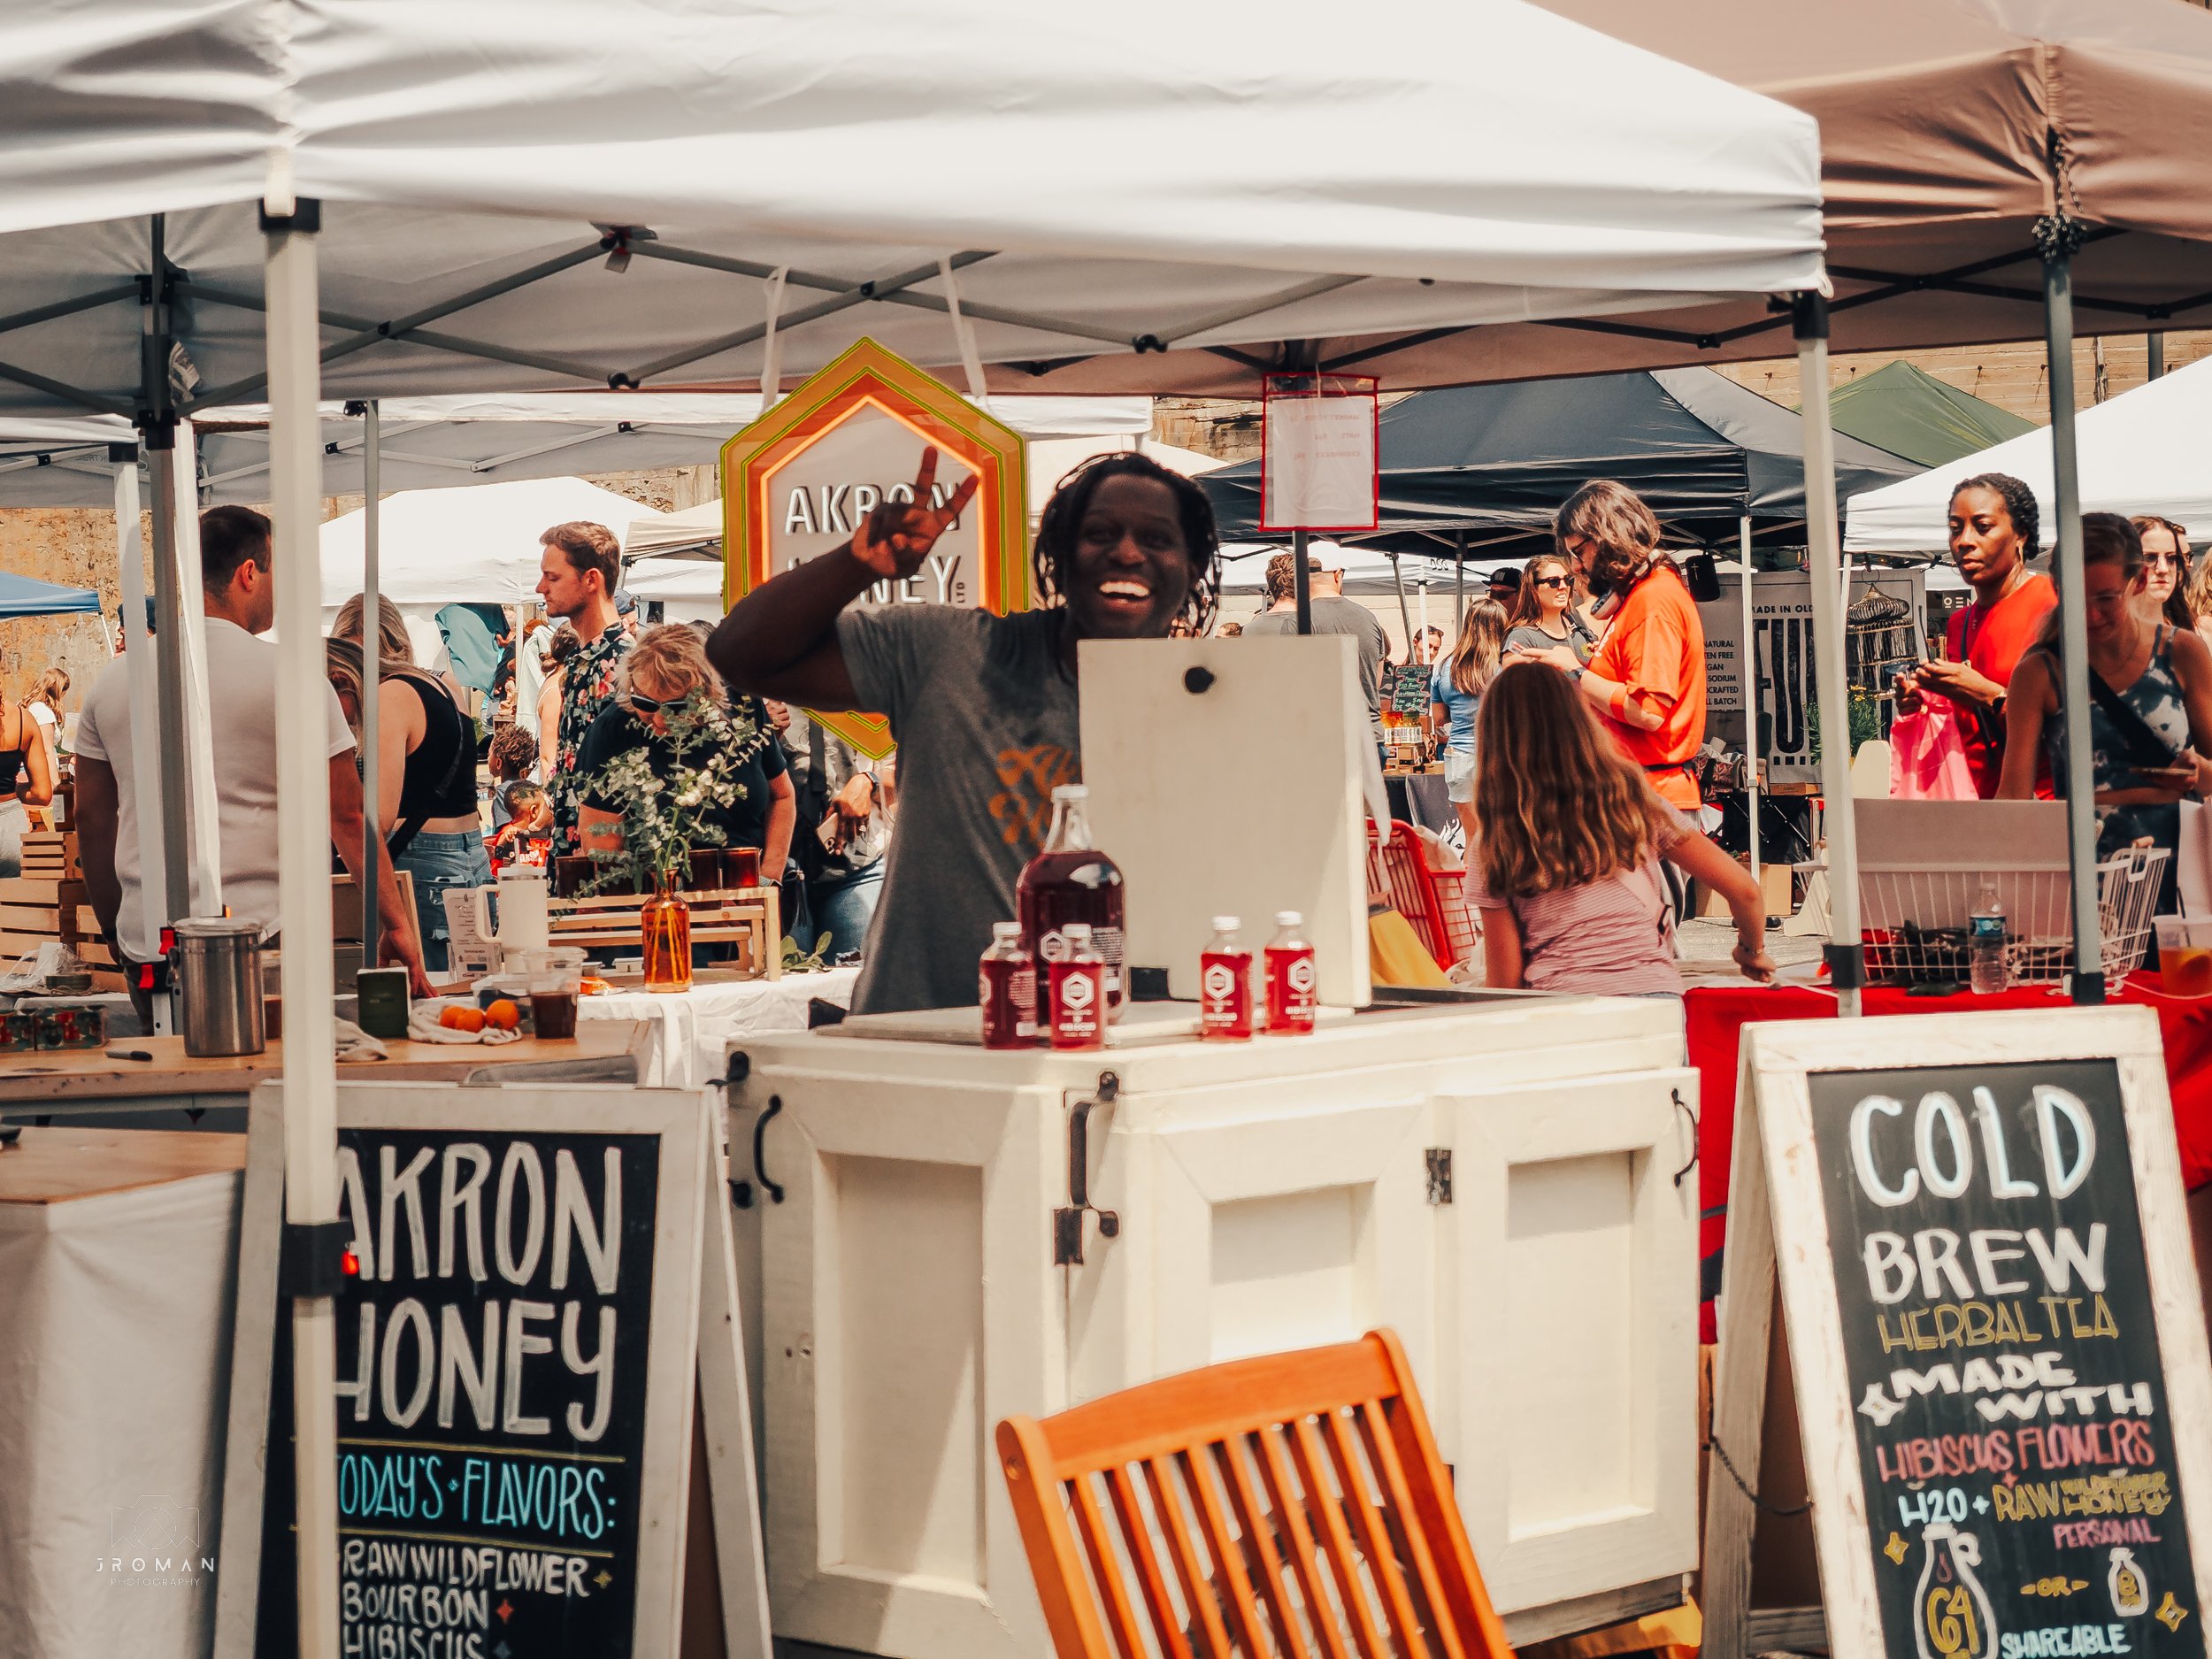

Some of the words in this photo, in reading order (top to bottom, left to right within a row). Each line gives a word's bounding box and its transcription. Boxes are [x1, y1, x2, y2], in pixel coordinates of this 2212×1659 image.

[1848, 1083, 2098, 1208] COLD
[338, 1141, 621, 1296] AKRON
[1862, 1221, 2108, 1306] BREW
[1877, 1301, 2042, 1355] HERBAL
[2038, 1292, 2120, 1340] TEA
[1888, 1351, 2078, 1400] MADE
[1973, 1381, 2154, 1423] WITH
[1874, 1427, 2016, 1483] HIBISCUS
[2014, 1417, 2156, 1471] FLOWERS
[337, 1453, 443, 1519] ODAY'S
[461, 1457, 618, 1540] FLAVORS:
[1992, 1479, 2061, 1523] RAW
[2062, 1489, 2172, 1516] HONEY
[2052, 1517, 2162, 1550] PERSONAL
[342, 1539, 410, 1578] RAW
[410, 1543, 591, 1598] WILDFLOWER
[342, 1580, 489, 1629] BOURBON
[1926, 1585, 1981, 1655] 64
[342, 1624, 484, 1659] HIBISCUS
[2001, 1623, 2132, 1659] SHAREABLE
